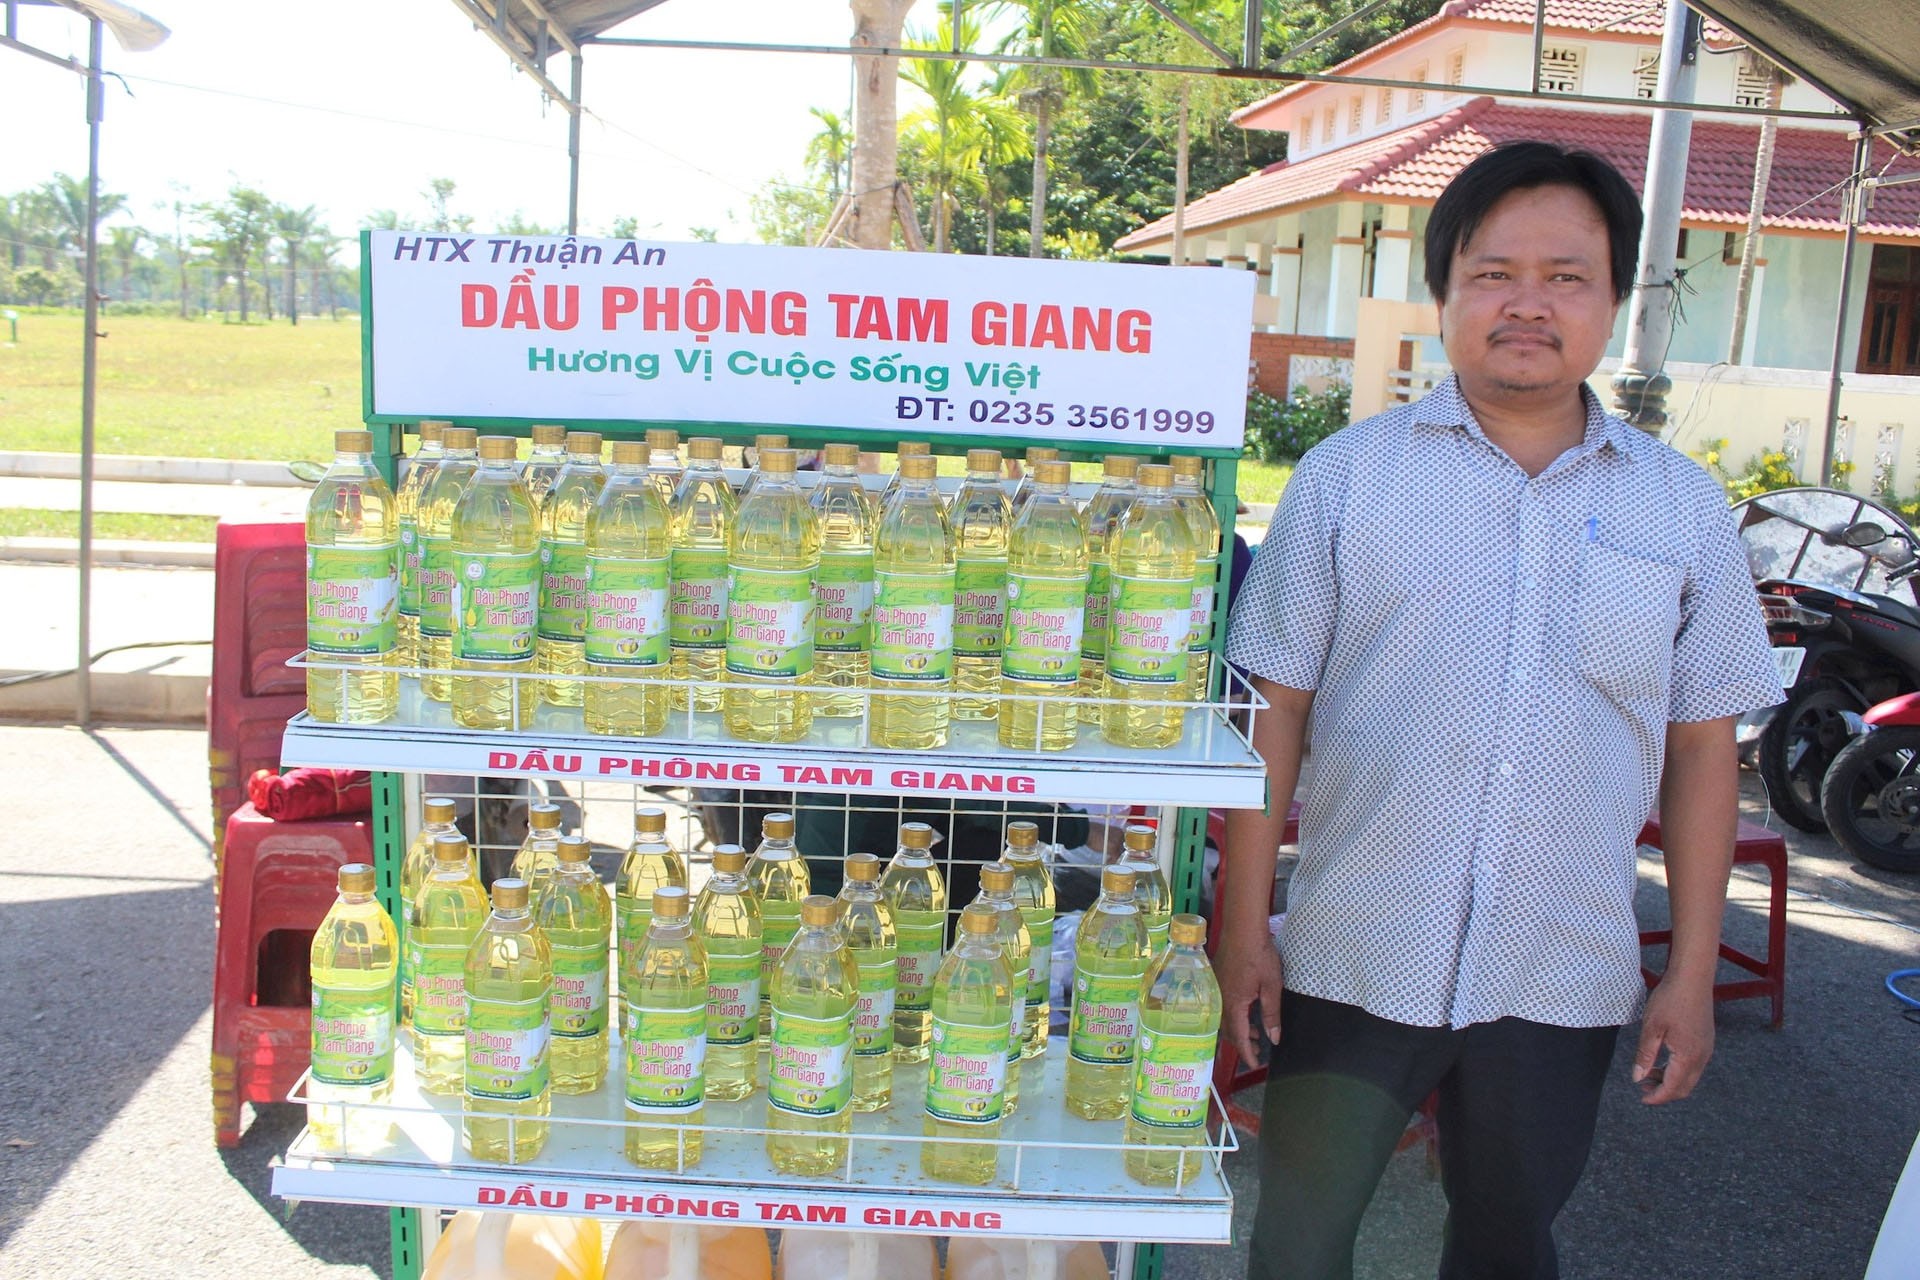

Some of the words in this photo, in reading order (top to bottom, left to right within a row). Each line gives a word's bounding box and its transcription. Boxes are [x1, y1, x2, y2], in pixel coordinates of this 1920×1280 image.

[394, 236, 477, 263] HTX
[488, 236, 602, 269] Thuận
[612, 241, 667, 266] An
[461, 268, 580, 331] DẦU
[602, 277, 807, 343] PHỘNG
[828, 293, 949, 344] TAM
[971, 301, 1153, 354] GIANG
[528, 346, 660, 380] Hương
[675, 348, 713, 381] Vị
[727, 351, 836, 385] Cuộc
[849, 353, 950, 393] Sống
[965, 362, 1041, 395] Việt
[896, 396, 955, 422] ĐT:
[969, 399, 1055, 427] 0235
[1067, 404, 1216, 434] 3561999
[488, 747, 582, 772] DẦU
[777, 765, 873, 786] TAM
[890, 770, 1036, 793] GIANG
[477, 1183, 569, 1208] DẦU
[584, 1194, 740, 1218] PHỘNG
[755, 1202, 846, 1223] TAM
[863, 1207, 1002, 1229] GIANG
